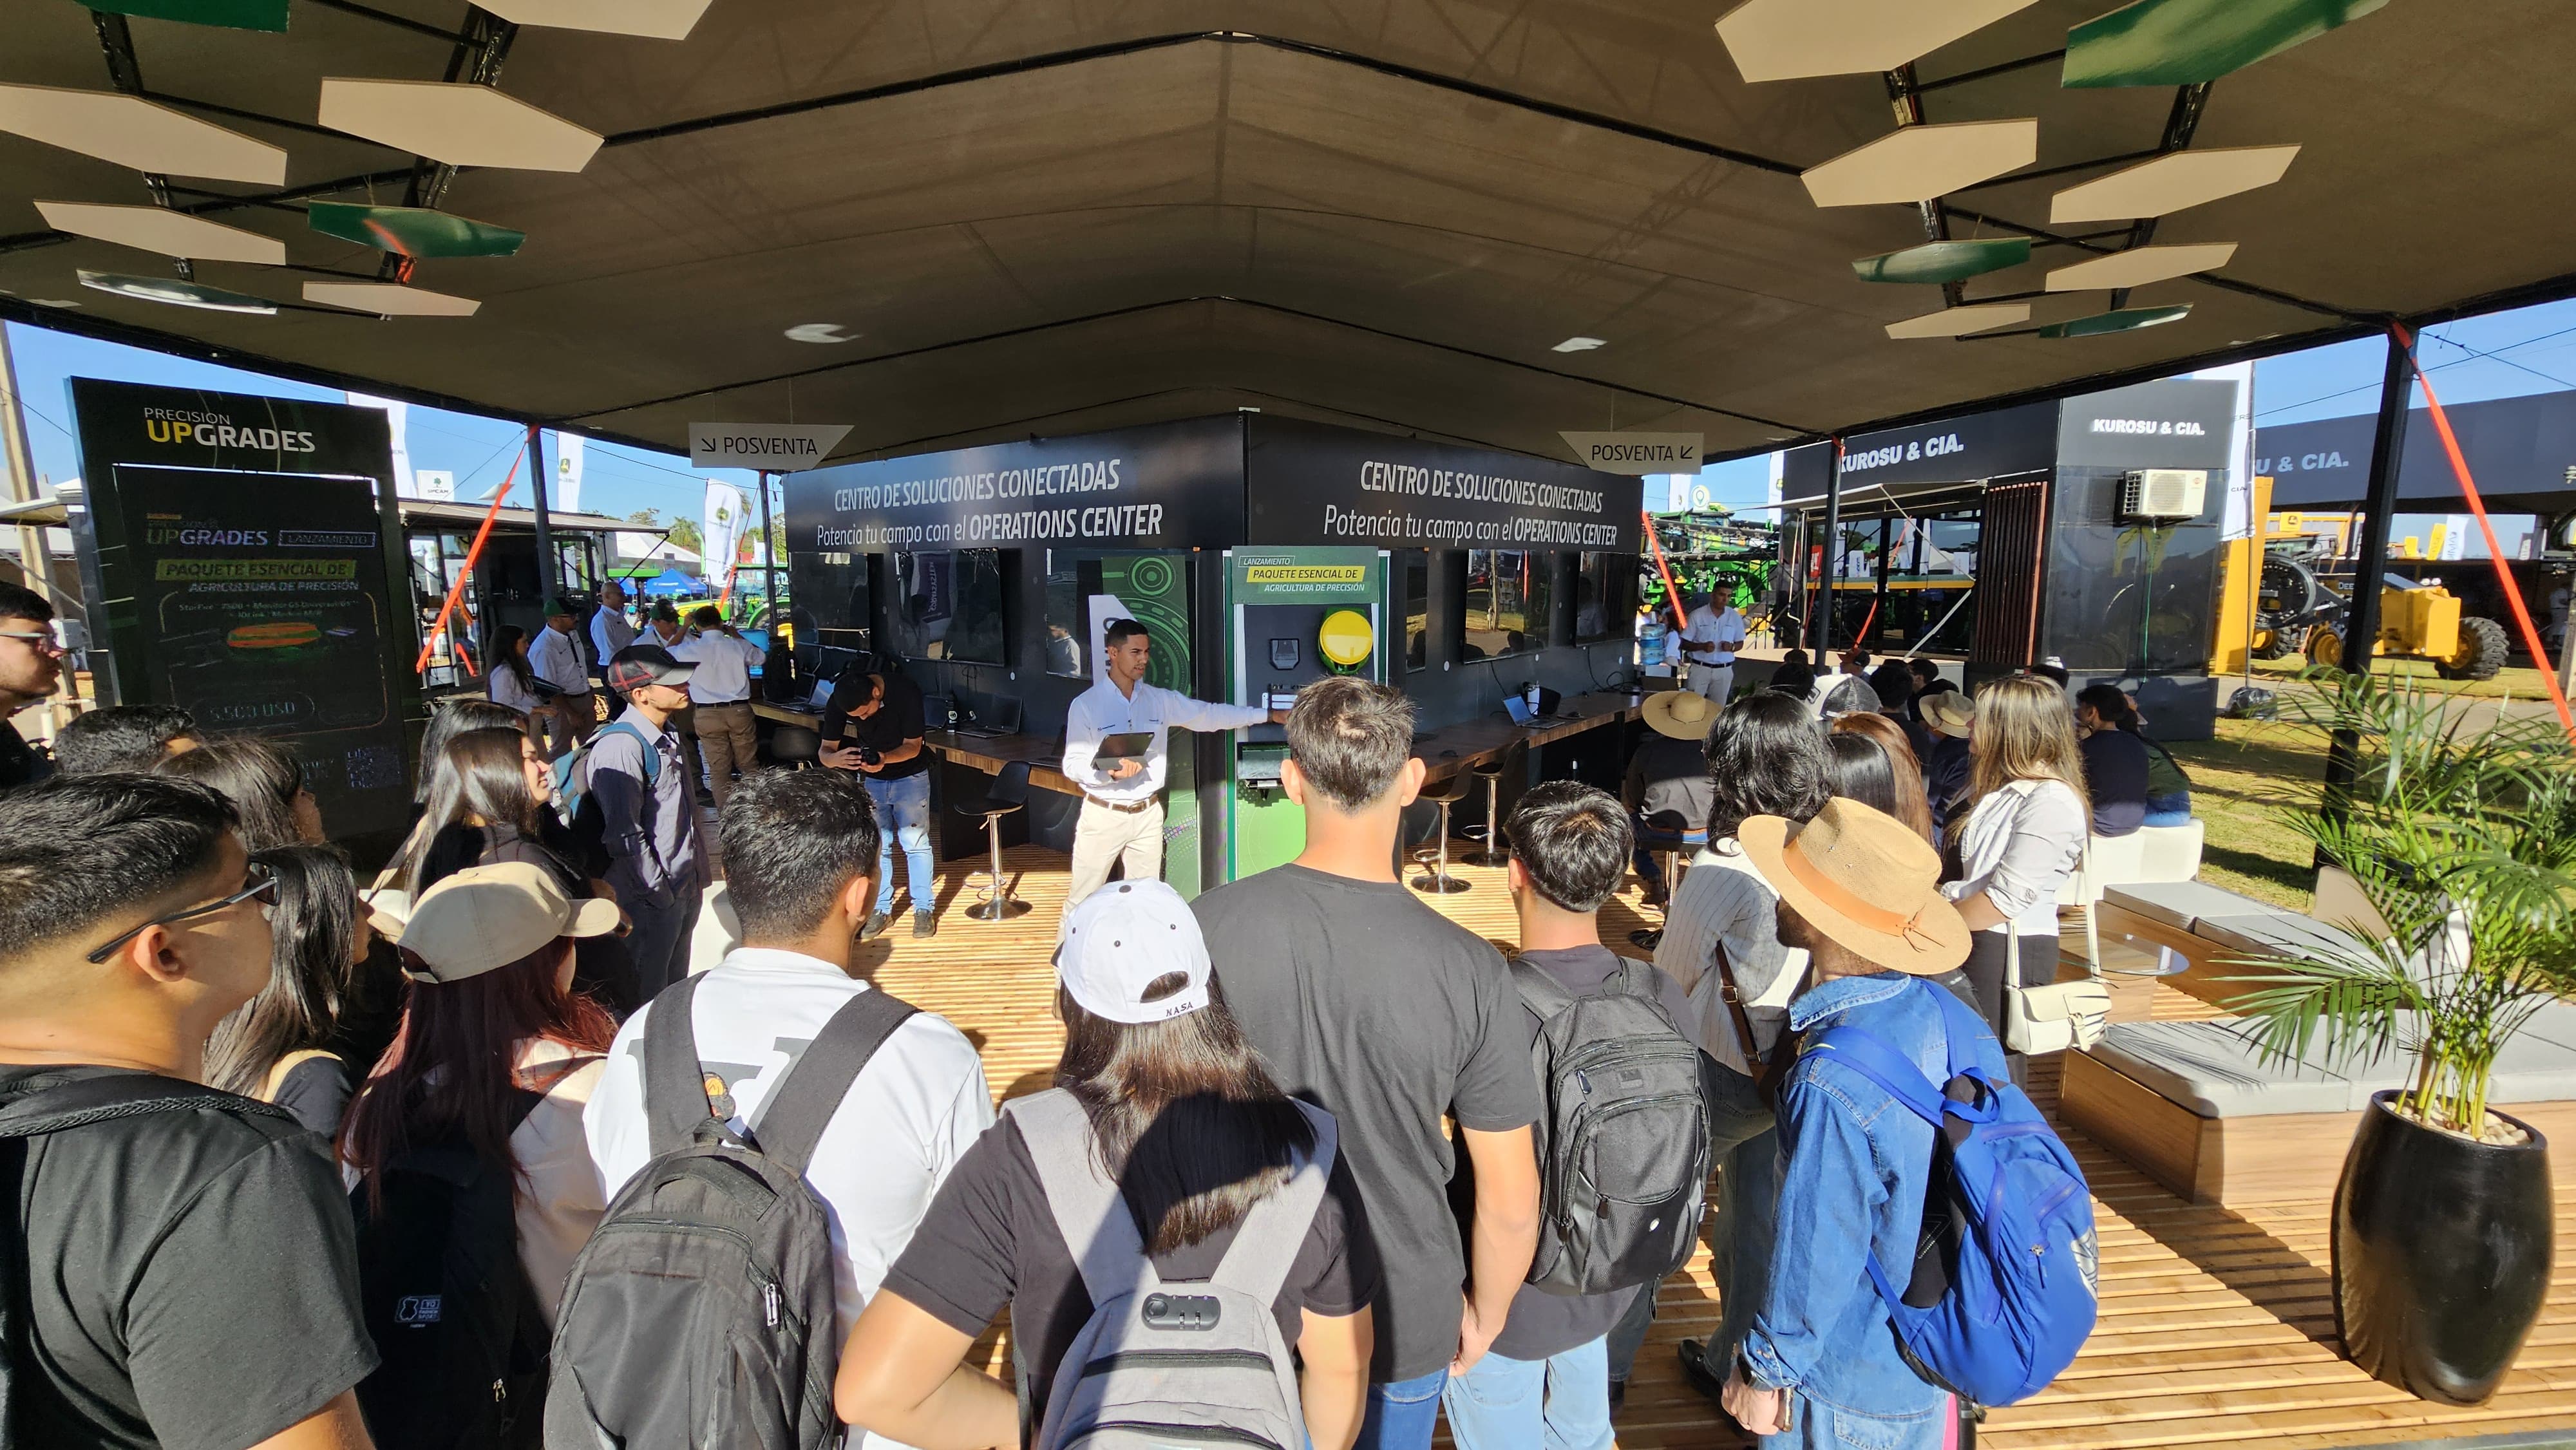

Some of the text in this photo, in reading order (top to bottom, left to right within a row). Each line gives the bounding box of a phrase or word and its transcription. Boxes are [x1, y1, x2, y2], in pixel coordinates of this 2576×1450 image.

[144, 407, 231, 425] PRECISION
[146, 419, 316, 453] UPGRADES
[2092, 419, 2206, 436] KUROSU & CIA.
[724, 437, 818, 455] POSVENTA
[1591, 444, 1674, 462] POSVENTA
[1906, 441, 1920, 461] &
[1925, 433, 1964, 458] CIA.
[2277, 455, 2294, 473] &
[2301, 451, 2349, 471] CIA.
[835, 458, 1121, 512] CENTRO DE SOLUCIONES CONECTADAS
[1360, 460, 1603, 514] CENTRO DE SOLUCIONES CONECTADAS
[817, 503, 1163, 551] Potencia tu campo con el OPERATIONS CENTER
[1323, 504, 1618, 547] Potencia tu campo con el OPERATIONS CENTER
[146, 529, 268, 545] UPGRADES
[166, 563, 347, 577] PAQUETE ESENCIAL DE
[1243, 557, 1291, 566] LANZAMIENTO
[1253, 569, 1358, 579] PAQUETE ESENCIAL DE
[188, 582, 276, 593] AGRICULTURA
[1264, 581, 1365, 592] AGRICULTURA DE PRECISIÓN
[1165, 1001, 1193, 1017] NASA
